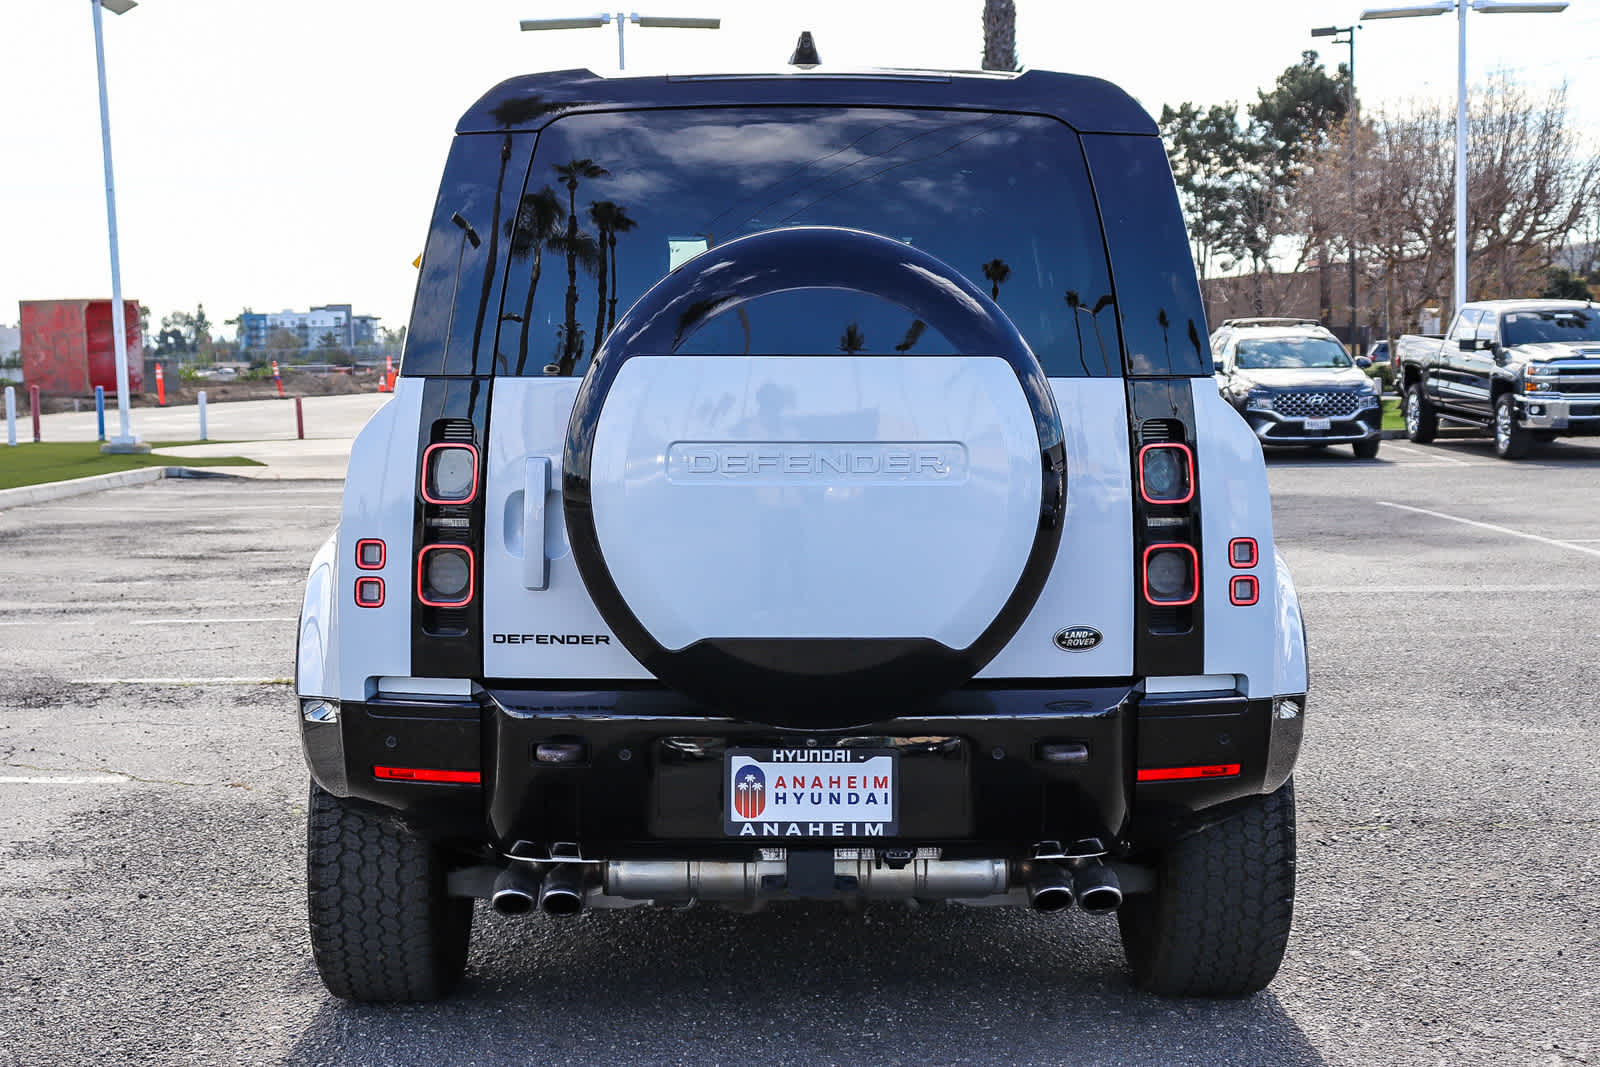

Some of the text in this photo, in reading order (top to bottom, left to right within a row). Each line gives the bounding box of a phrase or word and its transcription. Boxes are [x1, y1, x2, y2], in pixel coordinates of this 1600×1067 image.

[687, 452, 948, 475] DEFENDER
[492, 634, 611, 645] DEFENDER
[772, 749, 850, 762] HYUNDAI
[774, 775, 889, 789] ANAHEIM
[774, 792, 889, 805] HYUNDAI
[739, 822, 884, 836] ANAHEIM
